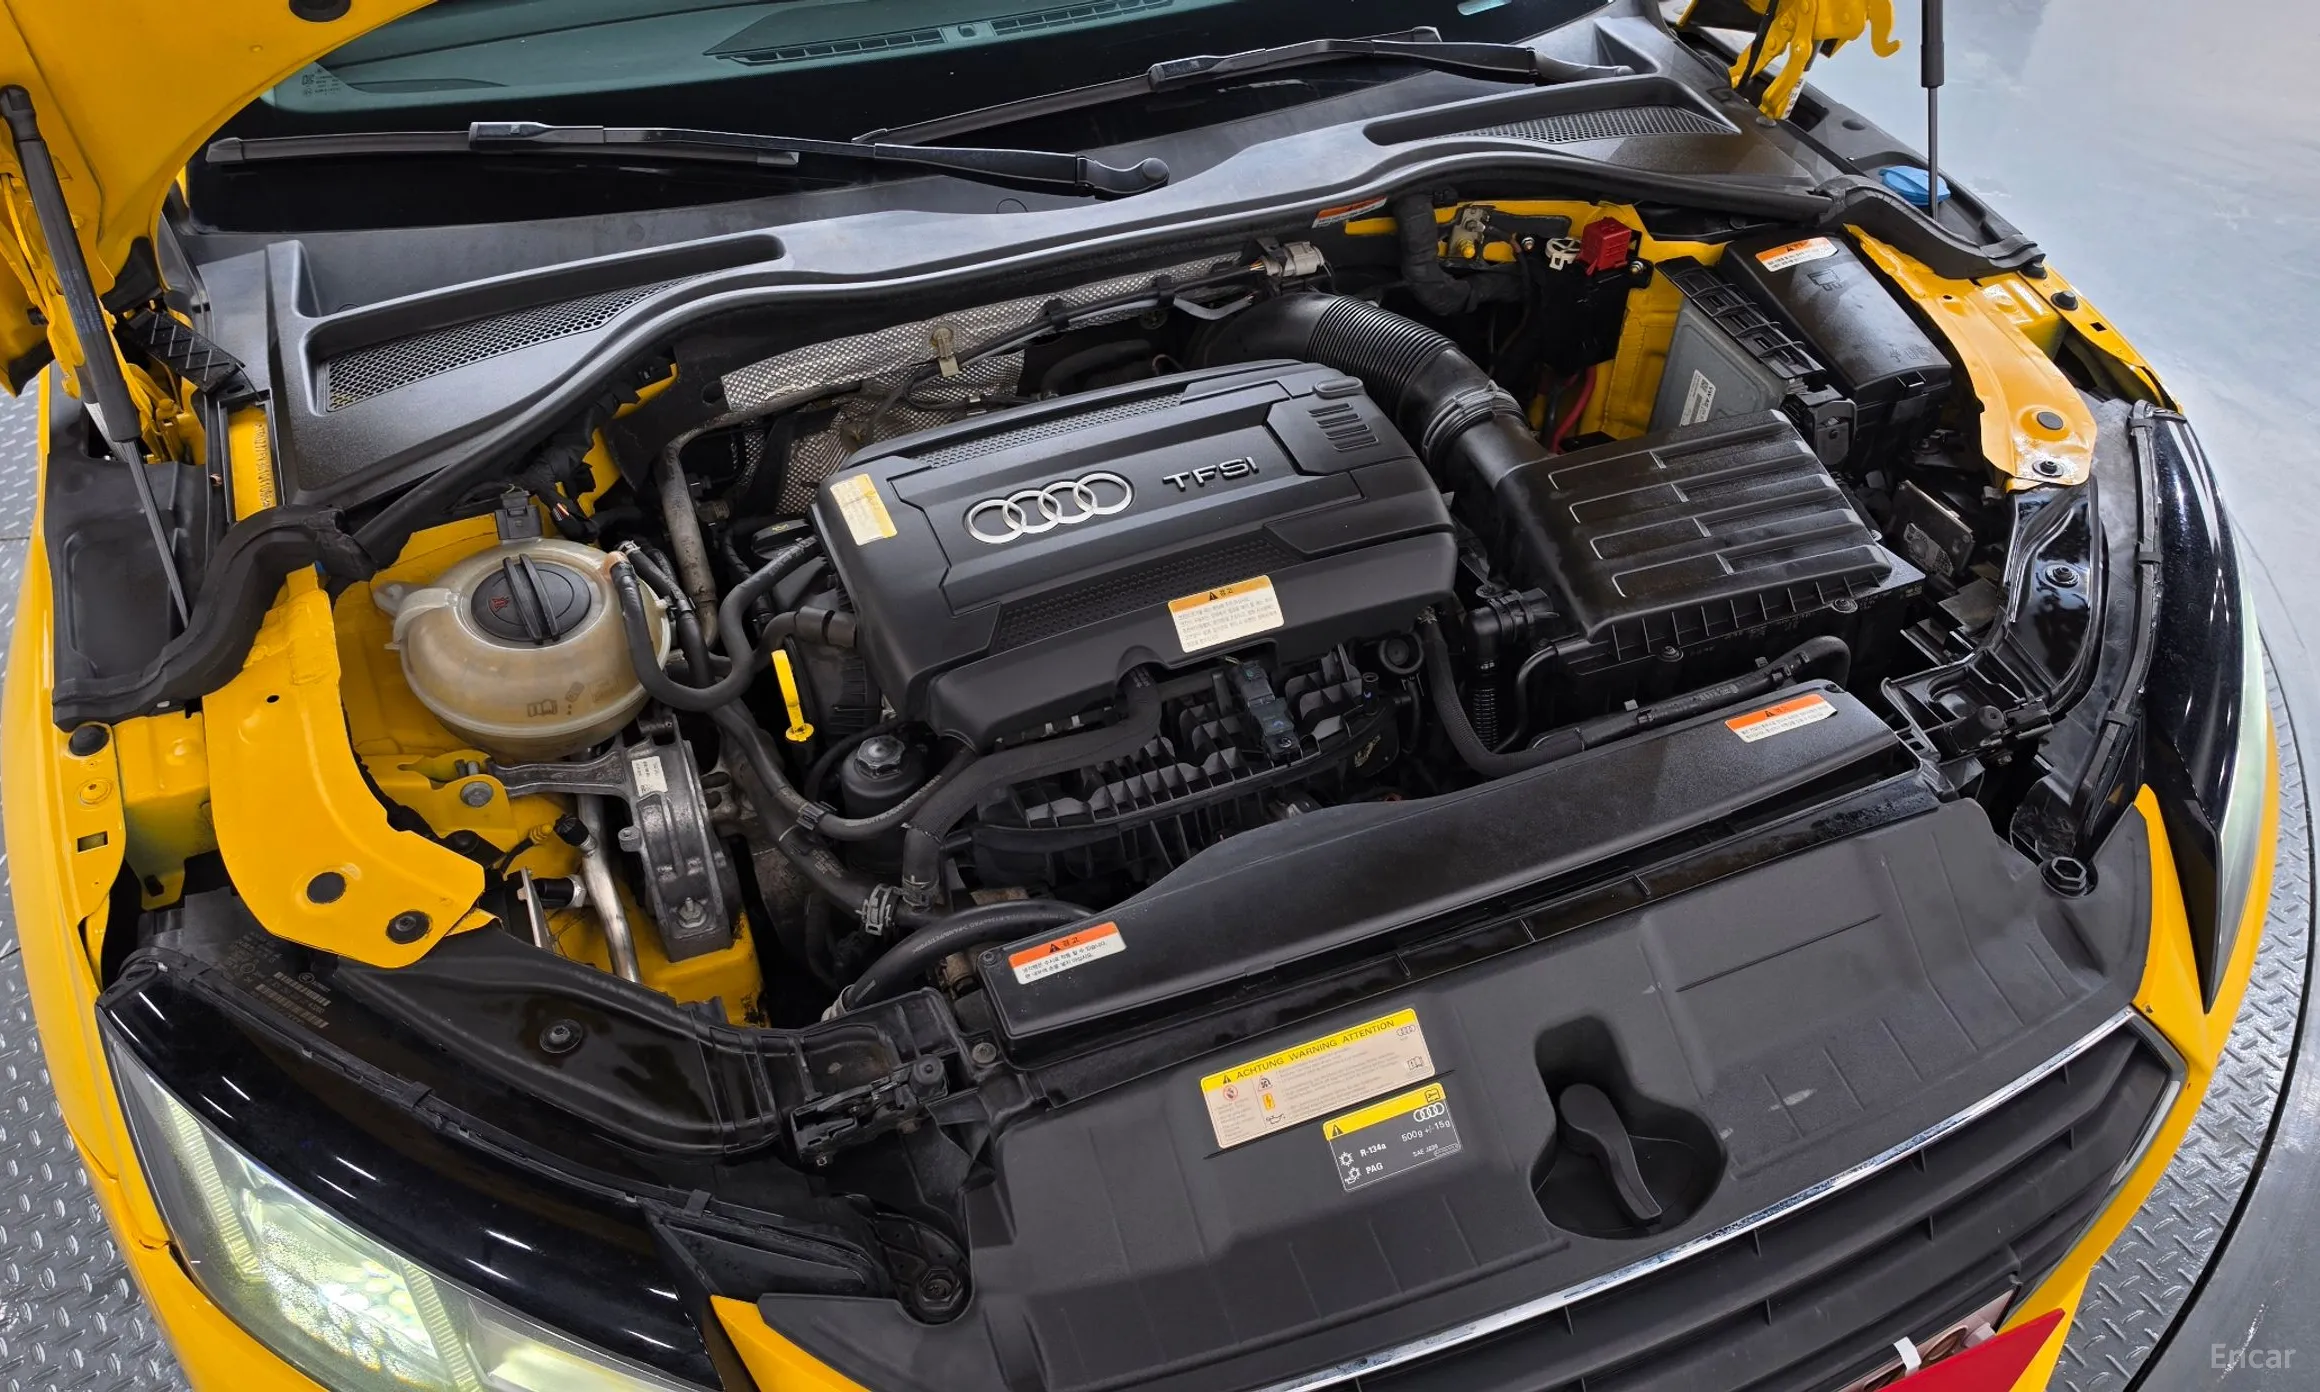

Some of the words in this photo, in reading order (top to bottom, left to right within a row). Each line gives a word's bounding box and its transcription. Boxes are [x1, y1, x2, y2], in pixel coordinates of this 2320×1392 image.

[1162, 456, 1259, 492] TFSI
[1236, 1058, 1285, 1080] ACHTUNG
[1288, 1039, 1338, 1061] WARNING
[1342, 1019, 1395, 1043] ATTENTION
[1360, 1143, 1387, 1157] R-134a
[1365, 1162, 1384, 1175] PAG
